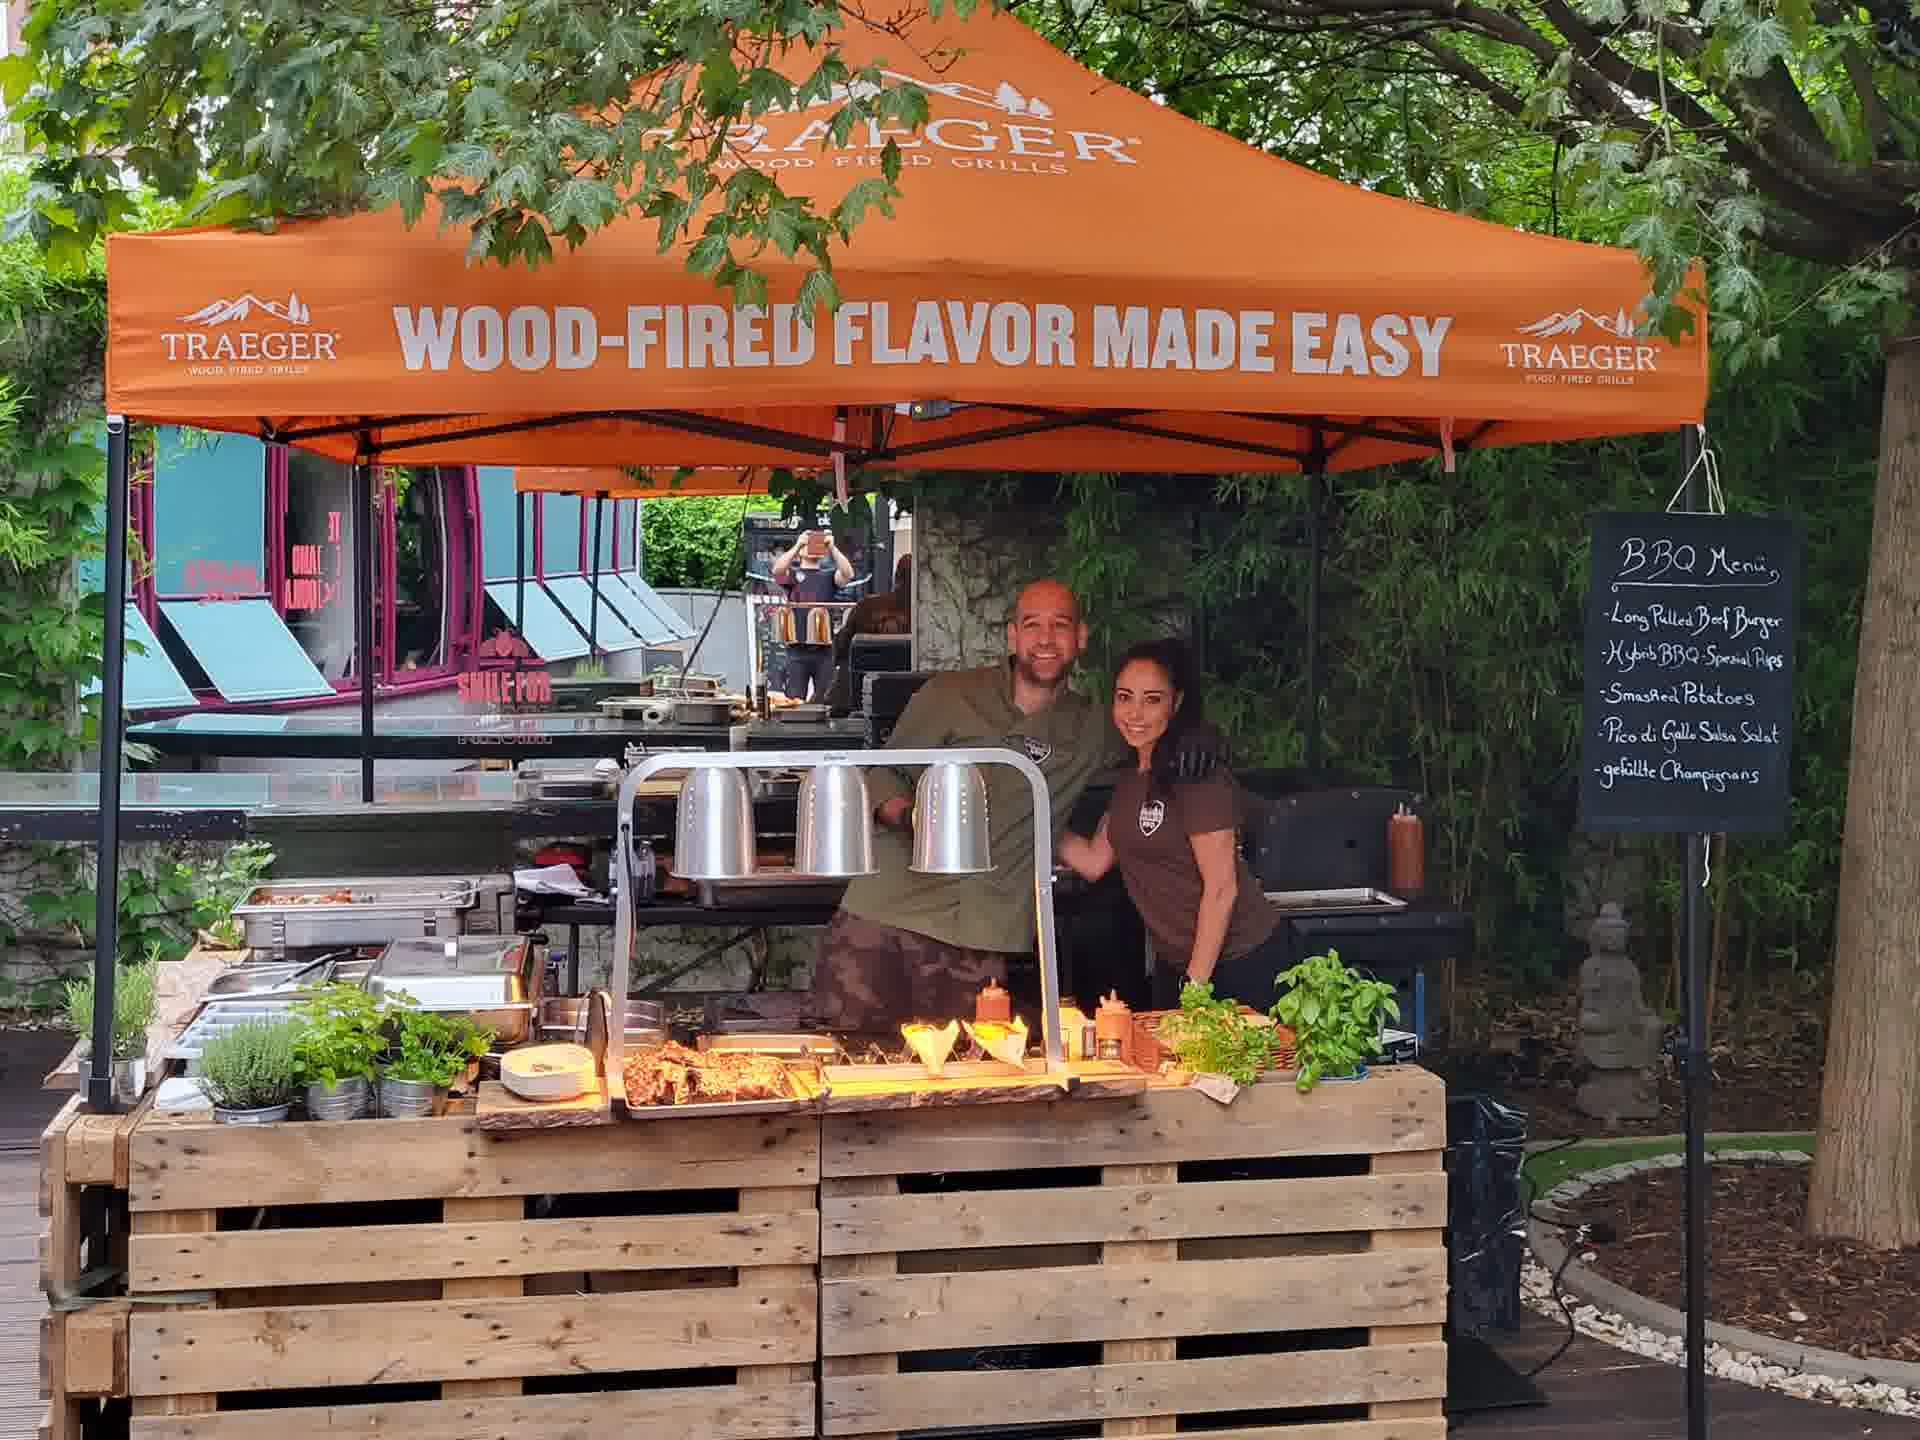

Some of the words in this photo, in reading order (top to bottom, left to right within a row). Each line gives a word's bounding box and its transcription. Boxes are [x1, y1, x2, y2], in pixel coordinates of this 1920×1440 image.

[716, 158, 814, 169] WOOD
[951, 158, 1069, 176] GRILLS
[160, 331, 337, 362] TRAEGER
[393, 302, 815, 371] WOOD-FIRED
[833, 300, 1076, 366] FLAVOR
[1093, 304, 1275, 372] MADE
[1290, 311, 1454, 377] EASY
[1500, 343, 1657, 371] TRAEGER
[1617, 537, 1697, 580] BBQ
[1648, 603, 1694, 630] Pulled
[1730, 605, 1784, 639] Burger
[1681, 681, 1756, 707] Potatoes
[1640, 723, 1658, 743] di
[1662, 719, 1697, 754] Gallo
[1698, 721, 1737, 743] Salsa
[1741, 721, 1780, 745] Salat
